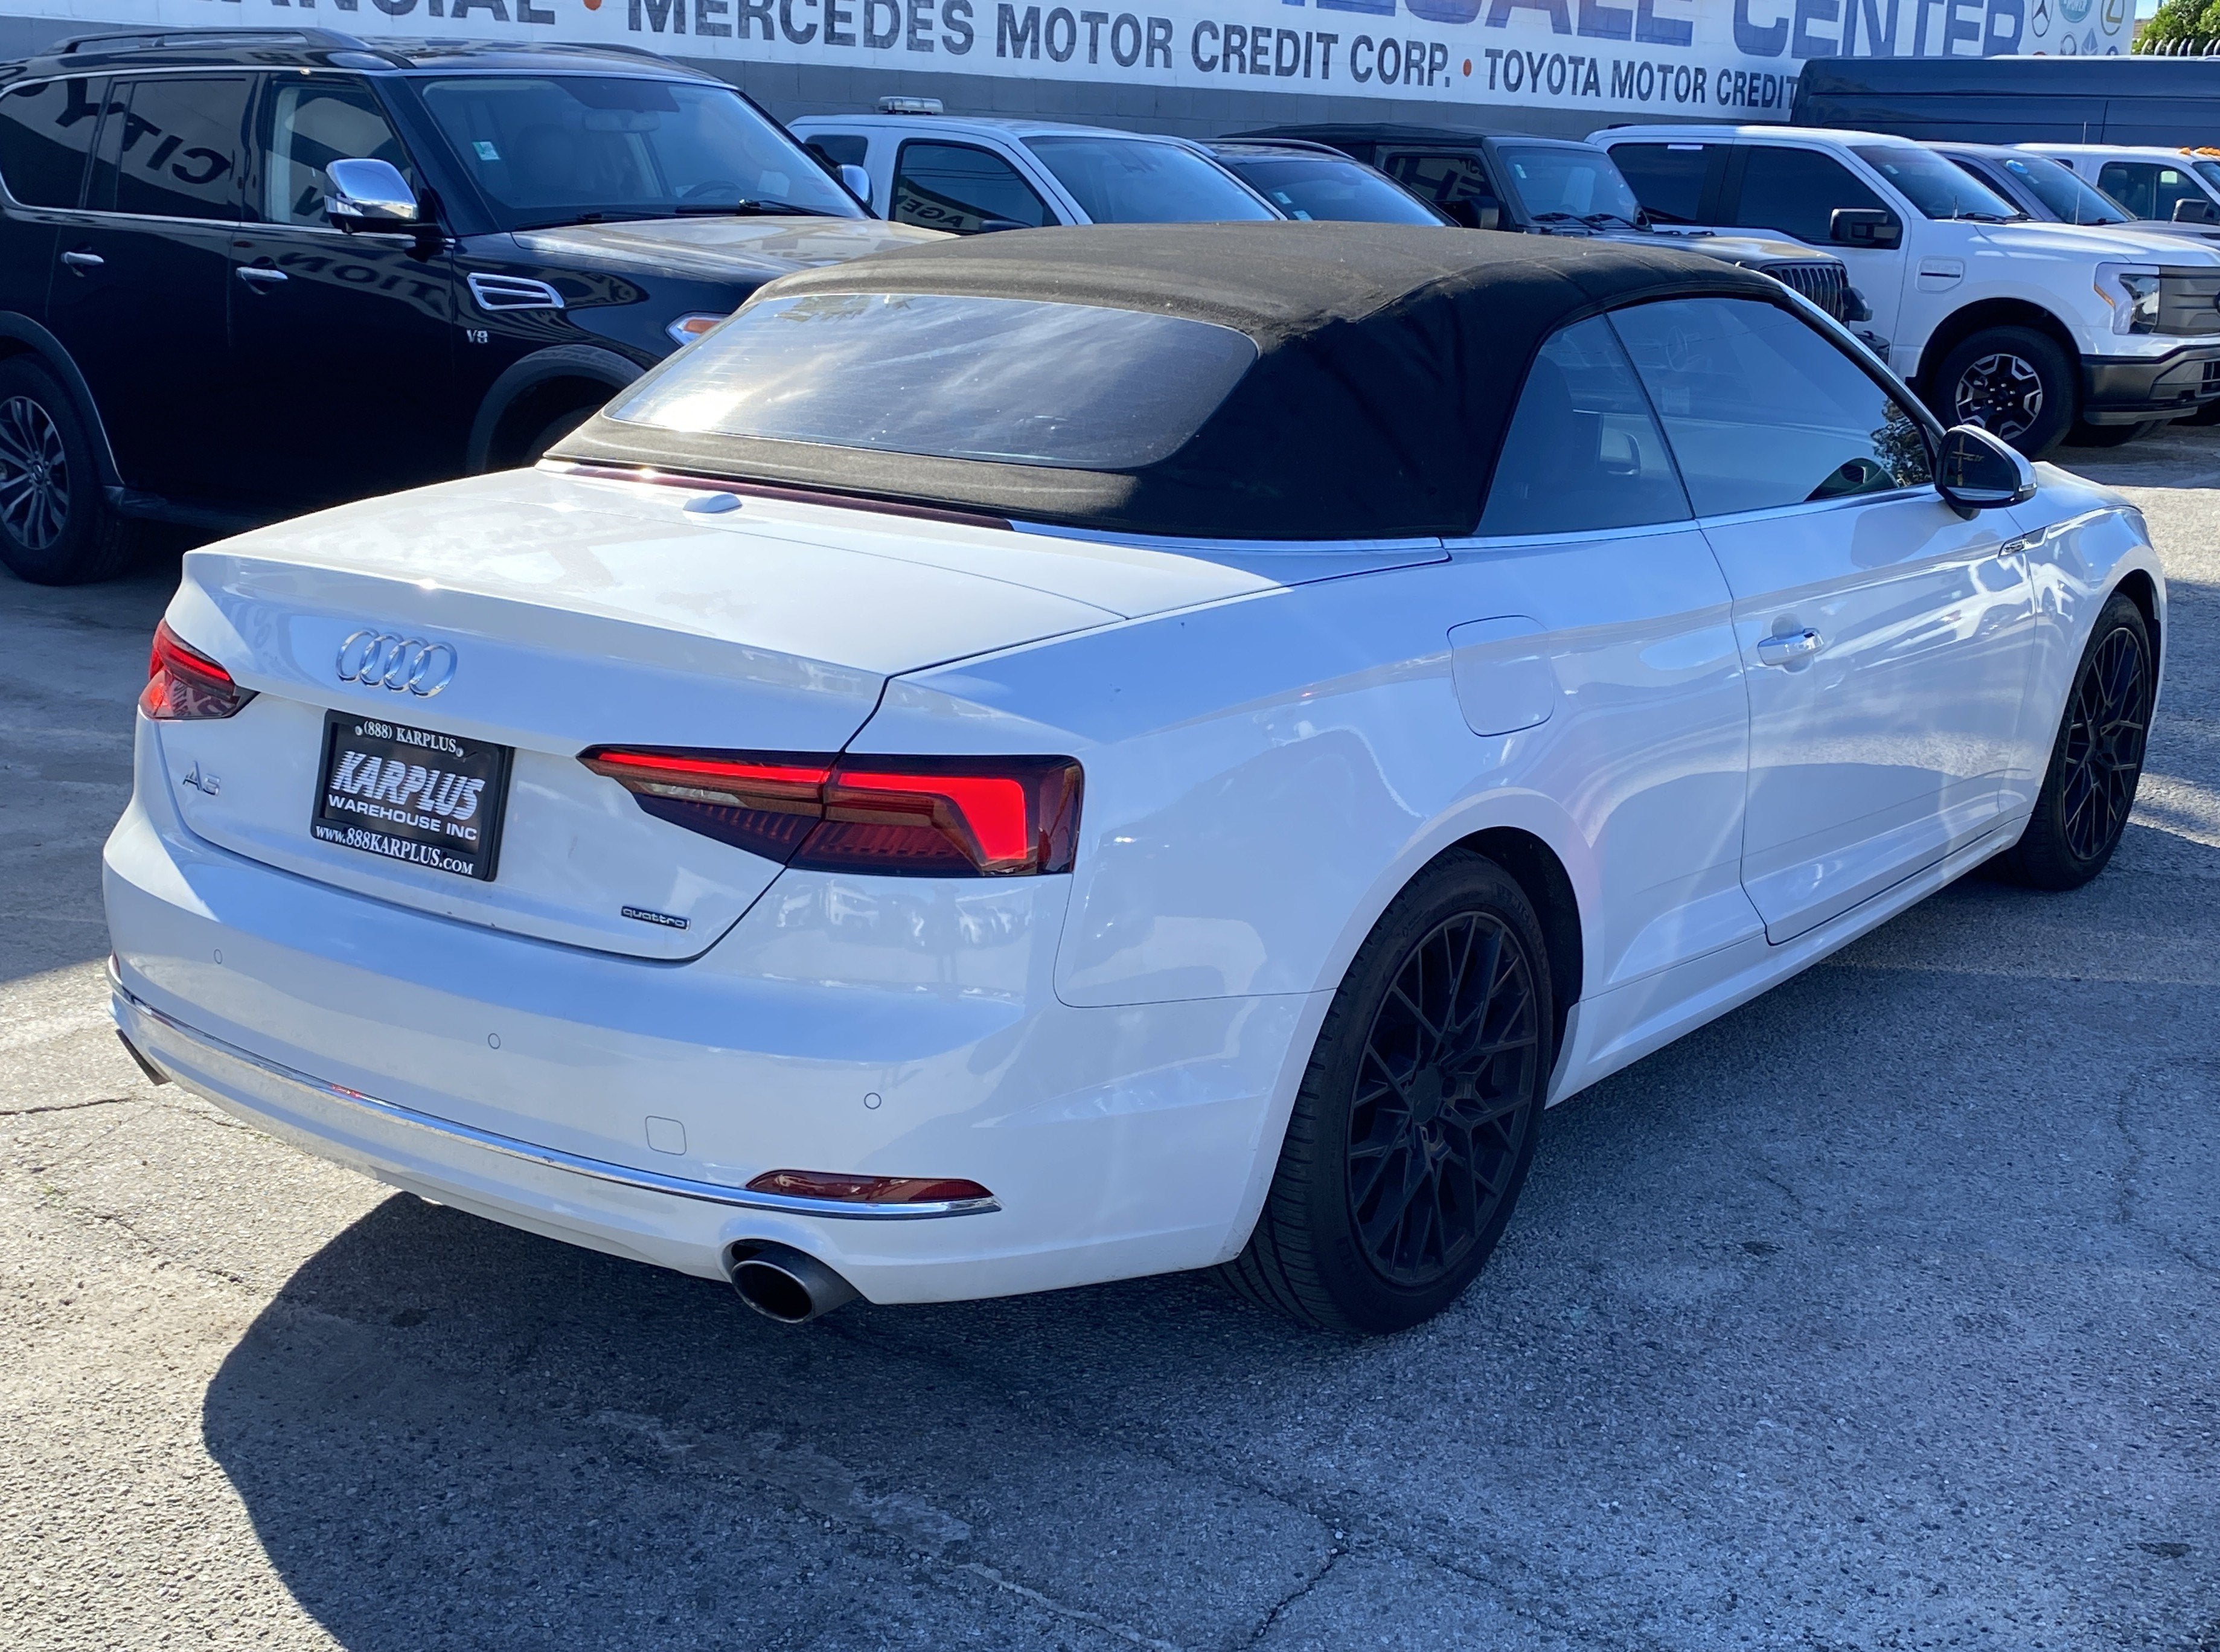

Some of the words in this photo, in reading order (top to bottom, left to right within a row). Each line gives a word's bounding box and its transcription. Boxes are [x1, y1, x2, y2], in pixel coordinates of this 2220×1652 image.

[628, 0, 974, 55] MERCEDES
[996, 4, 1173, 68] MOTOR
[1191, 21, 1339, 80] CREDIT
[1351, 34, 1450, 87] CORP.
[1485, 48, 1601, 97] TOYOTA
[1611, 60, 1706, 103] MOTOR
[1716, 69, 1798, 109] CREDIT
[466, 329, 488, 344] V8
[363, 720, 393, 740] (888)
[396, 727, 457, 753] KARPLUS
[182, 760, 220, 796] A5
[330, 751, 485, 820] KARPLUS
[328, 794, 441, 831] WAREHOUSE
[446, 822, 478, 841] INC
[622, 908, 685, 927] quattro
